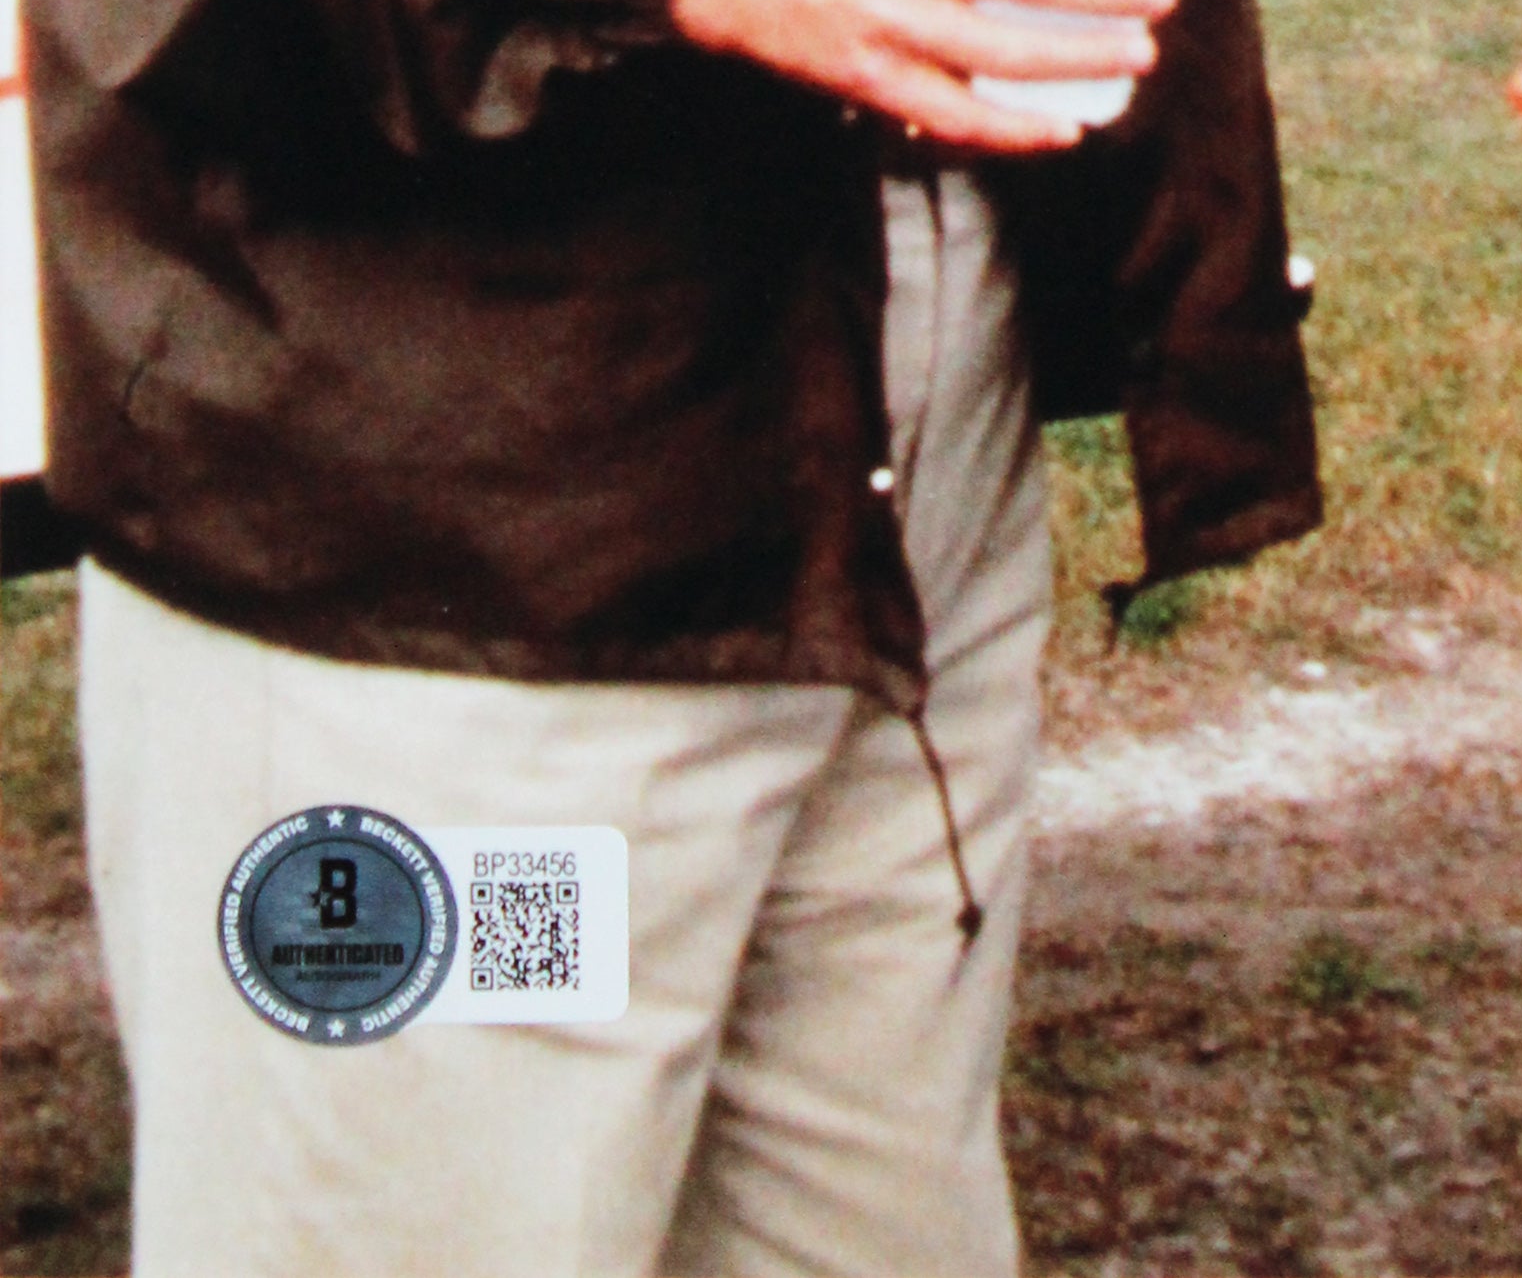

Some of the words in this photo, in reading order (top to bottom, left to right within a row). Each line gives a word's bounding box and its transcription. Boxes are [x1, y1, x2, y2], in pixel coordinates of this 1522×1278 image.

[231, 816, 310, 892] AUTHENTIC
[360, 816, 429, 872] BECKETT
[473, 851, 577, 878] BP33456
[318, 858, 357, 928] B
[420, 870, 448, 955] VERIFIED
[223, 891, 249, 979] VERIFIED
[271, 944, 405, 965] AUTHENTICATED
[239, 975, 311, 1032] BECKETT
[361, 955, 438, 1032] AUTHENTIC
